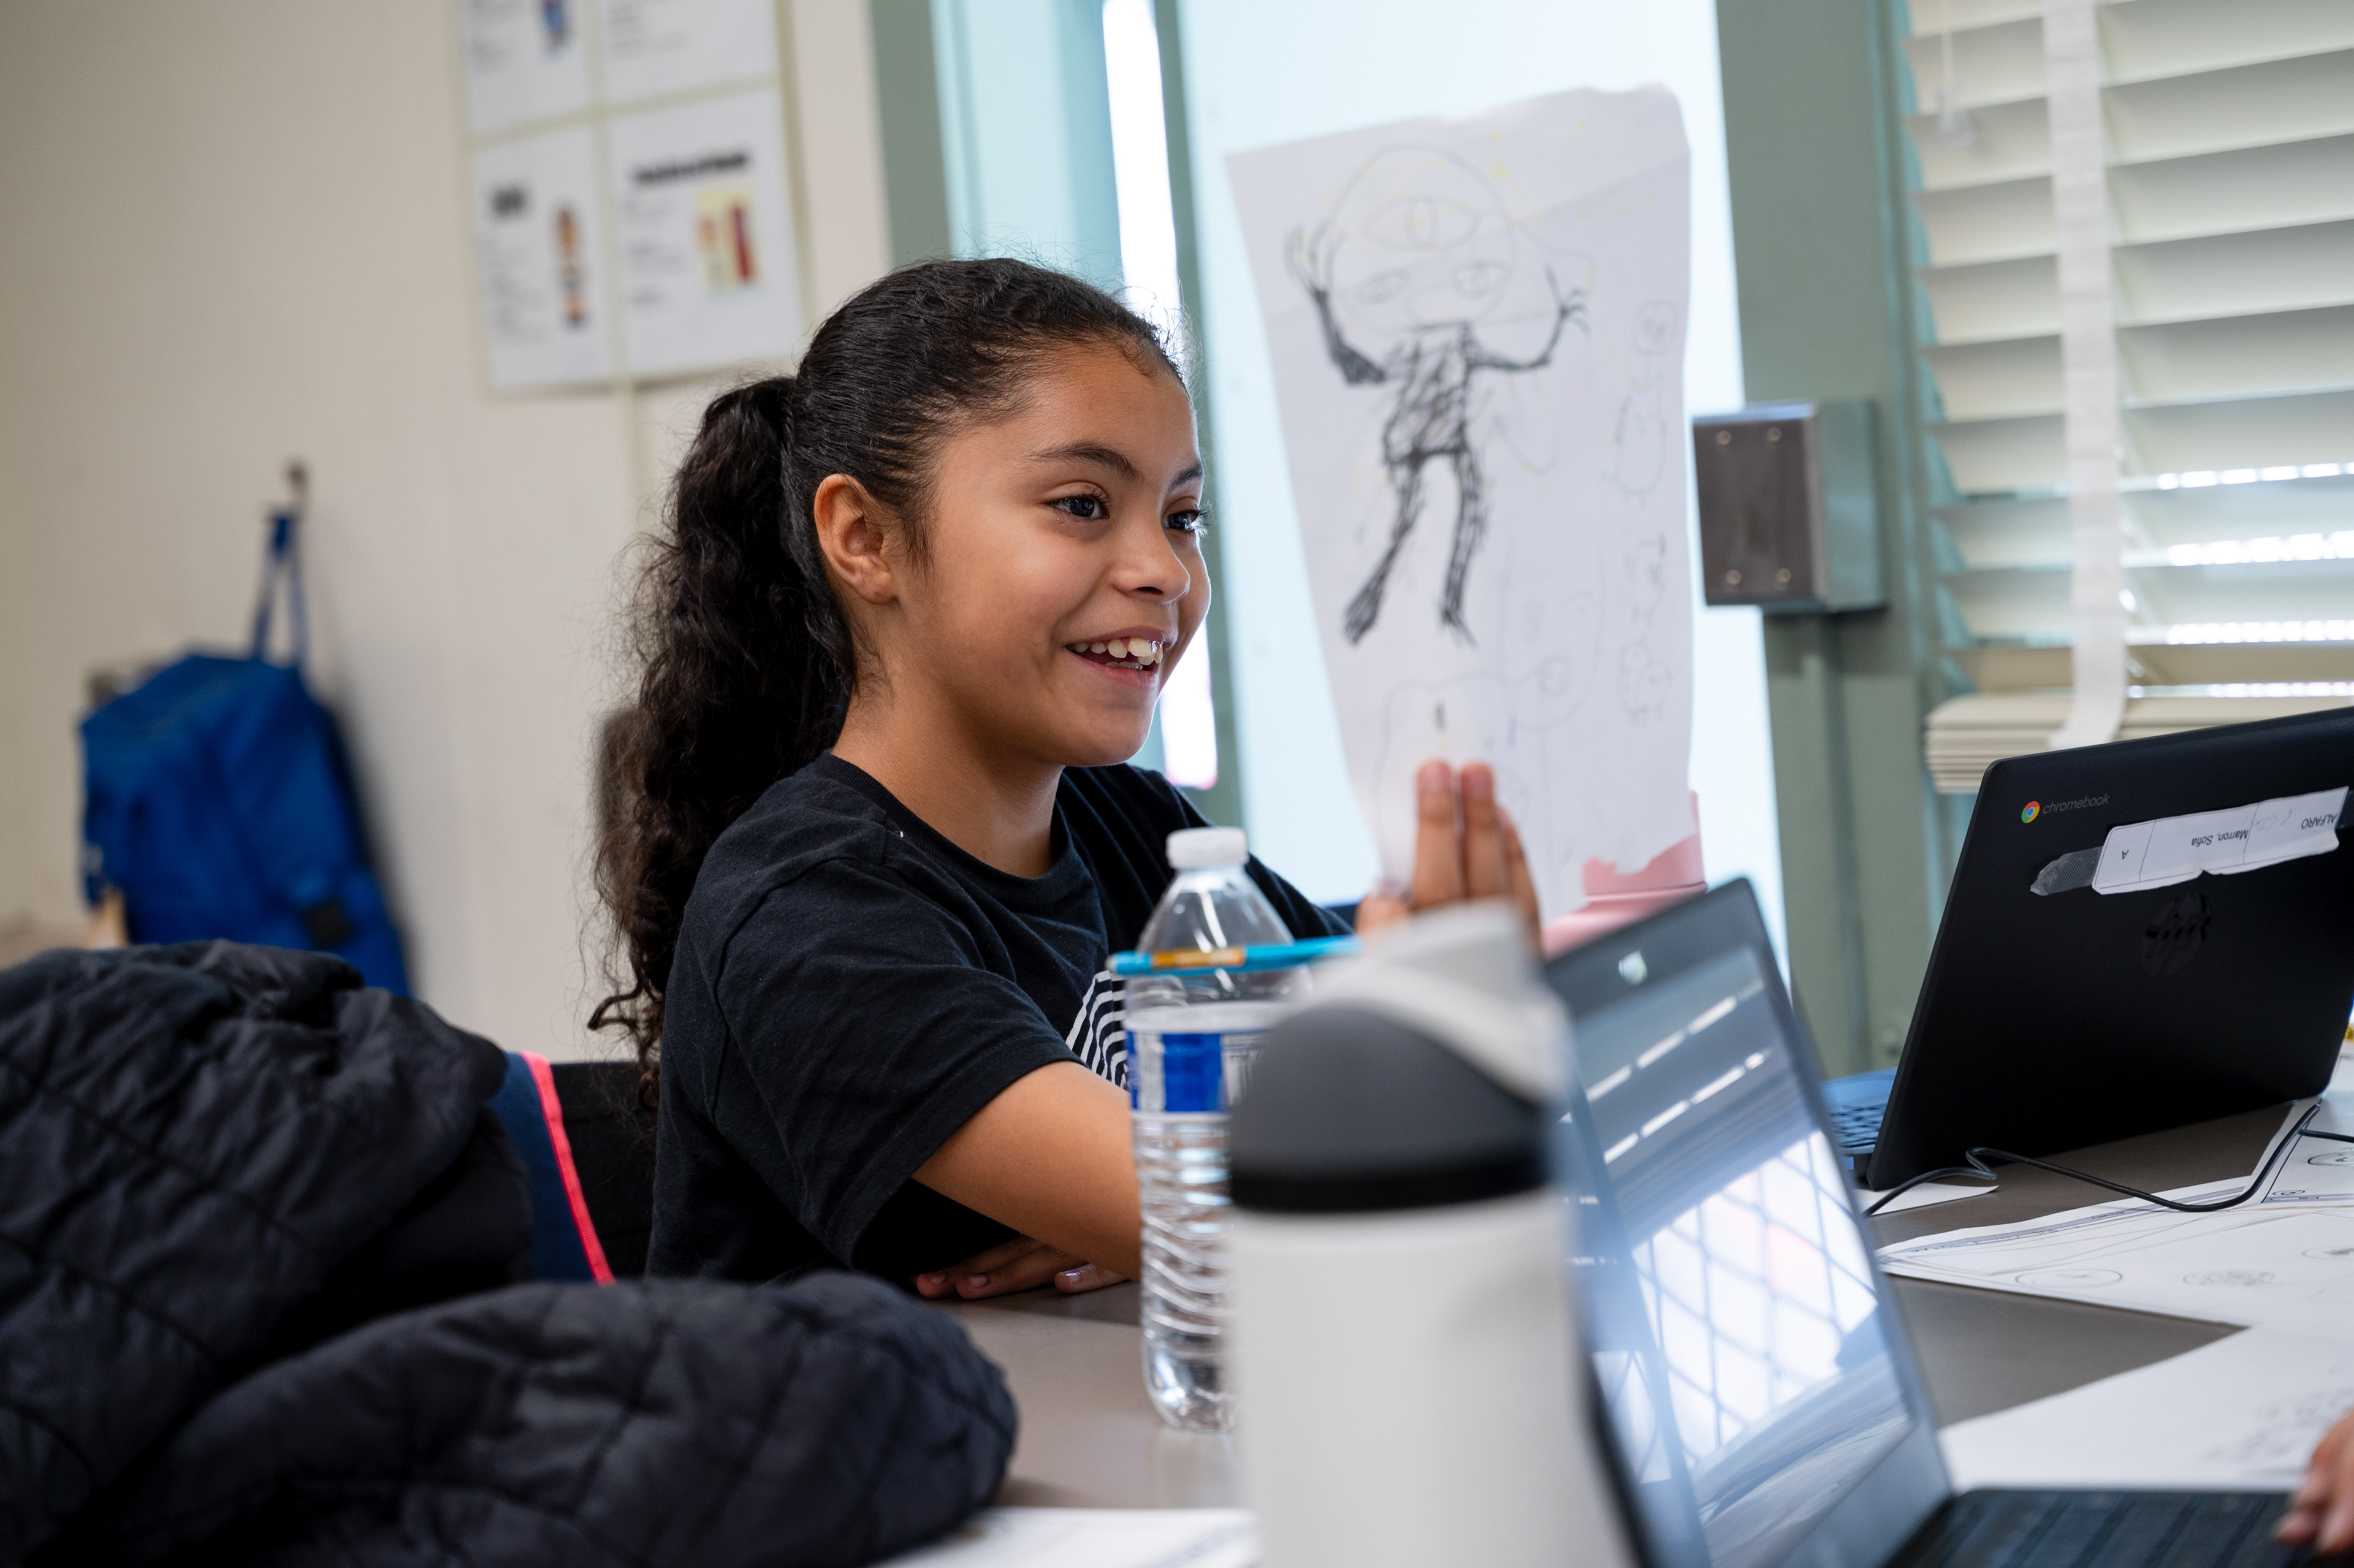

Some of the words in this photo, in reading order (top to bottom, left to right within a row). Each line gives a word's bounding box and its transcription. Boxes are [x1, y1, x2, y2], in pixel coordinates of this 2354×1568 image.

[2043, 793, 2110, 814] chromebook
[2301, 813, 2338, 830] ALFARO
[2191, 835, 2214, 848] Sofia
[2217, 829, 2249, 842] Marron,
[2121, 849, 2130, 860] A
